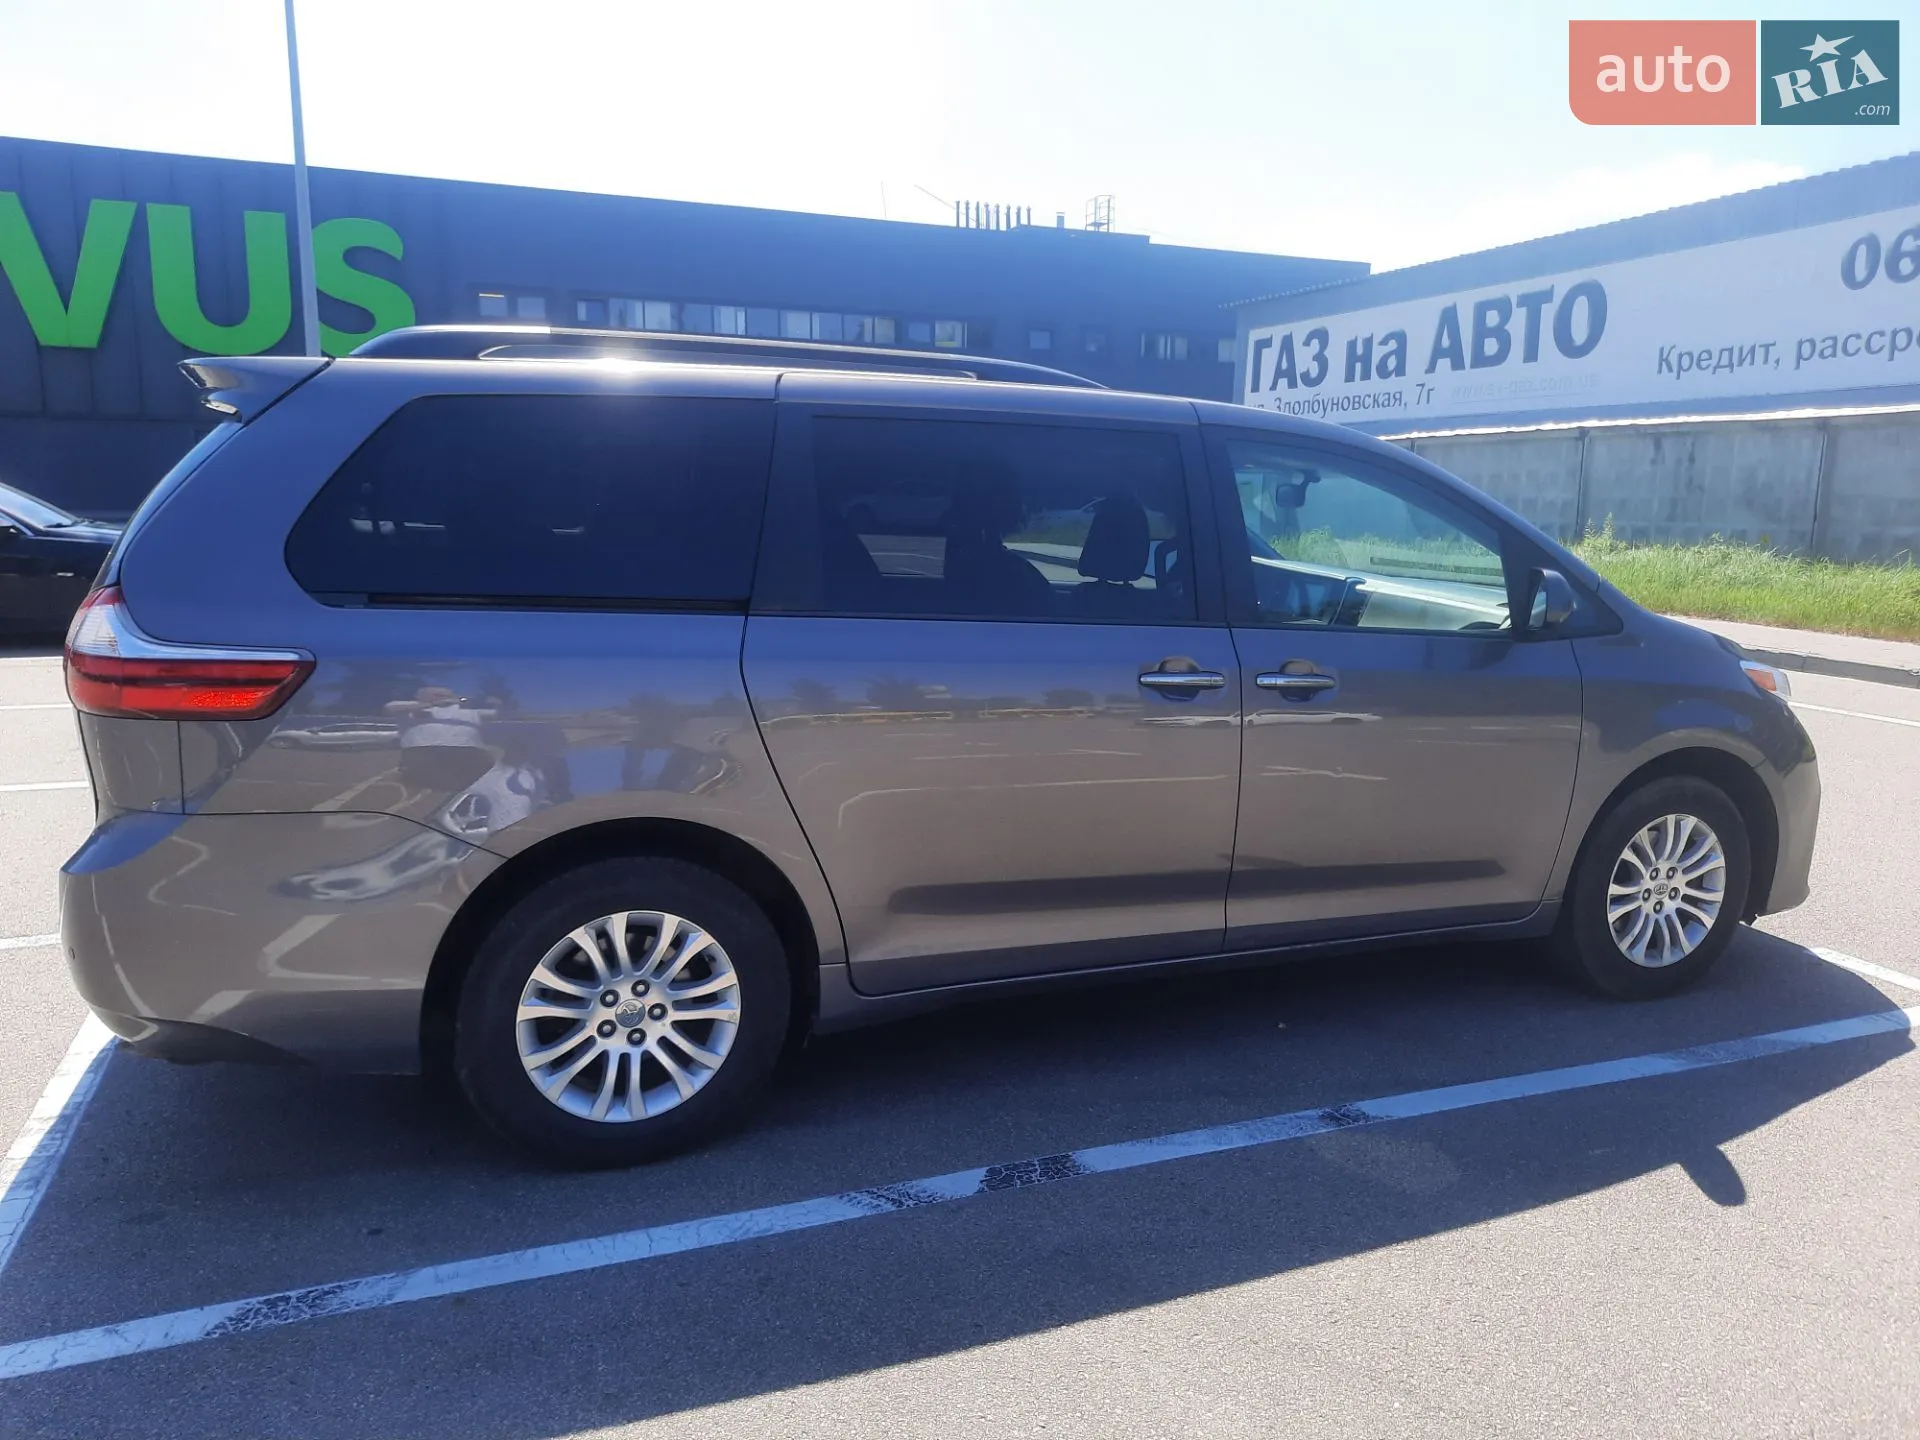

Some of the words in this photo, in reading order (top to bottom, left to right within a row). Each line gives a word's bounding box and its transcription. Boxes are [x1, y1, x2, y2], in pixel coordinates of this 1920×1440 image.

[1249, 325, 1330, 393] ГАЗ
[1344, 328, 1408, 383] на
[1424, 278, 1608, 374] АВТО
[1656, 341, 1781, 381] Кредит,
[1793, 326, 1920, 371] расср
[1415, 382, 1436, 406] 7г
